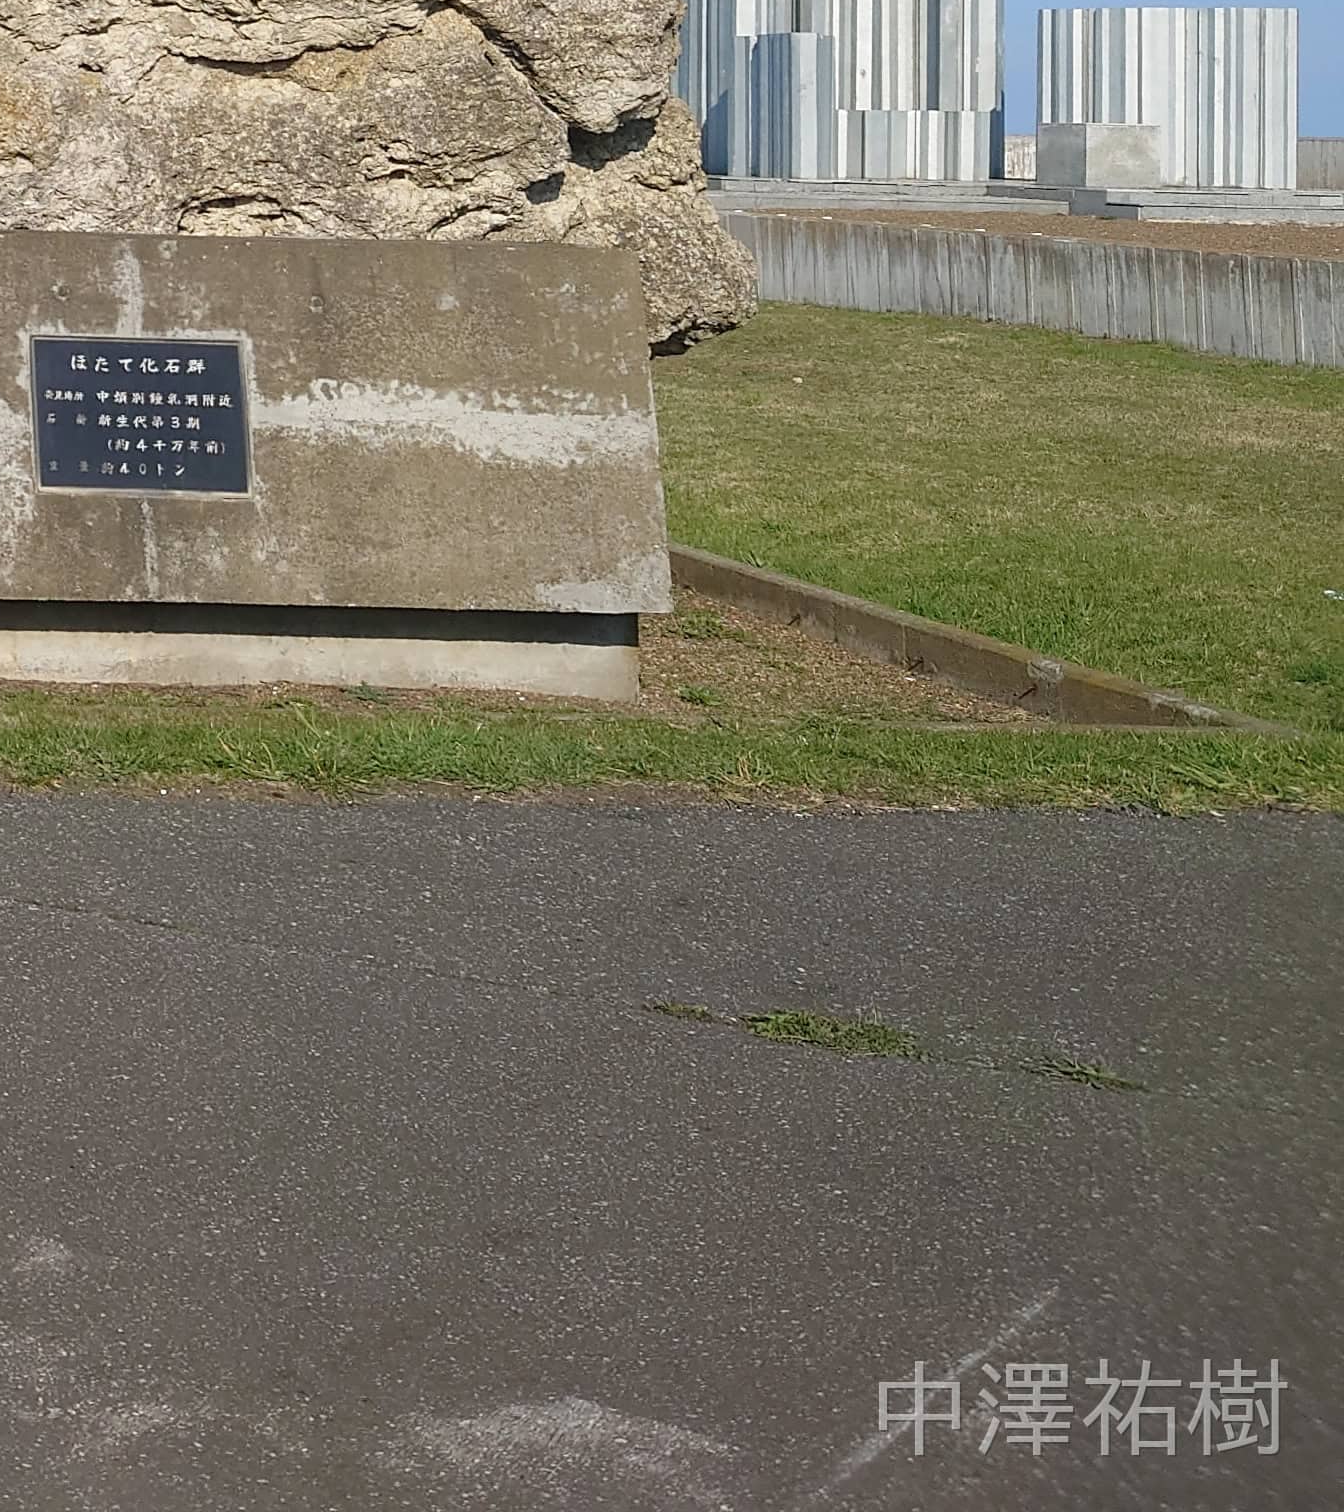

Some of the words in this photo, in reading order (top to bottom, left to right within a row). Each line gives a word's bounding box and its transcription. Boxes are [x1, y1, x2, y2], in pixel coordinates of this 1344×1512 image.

[70, 354, 207, 375] ほたて化石群
